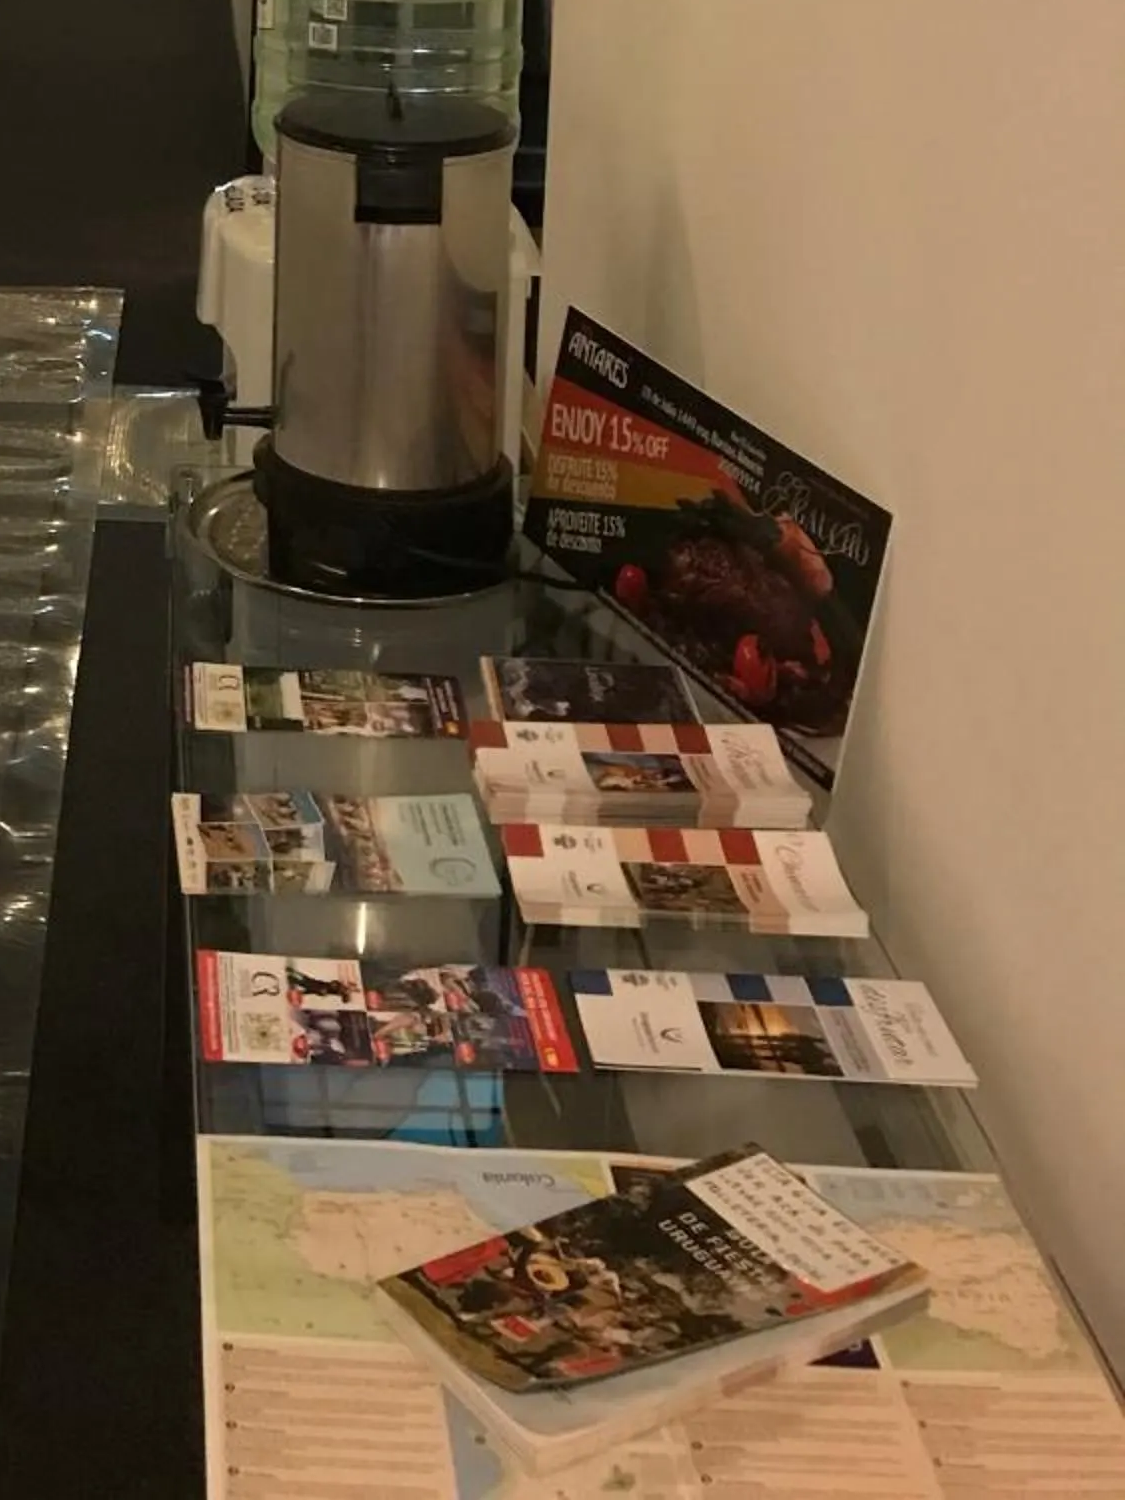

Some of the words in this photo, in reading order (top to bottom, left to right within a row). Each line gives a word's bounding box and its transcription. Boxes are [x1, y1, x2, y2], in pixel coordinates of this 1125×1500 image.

[568, 331, 630, 389] ANTARES
[552, 403, 606, 446] ENJOY
[678, 1212, 709, 1235] DE
